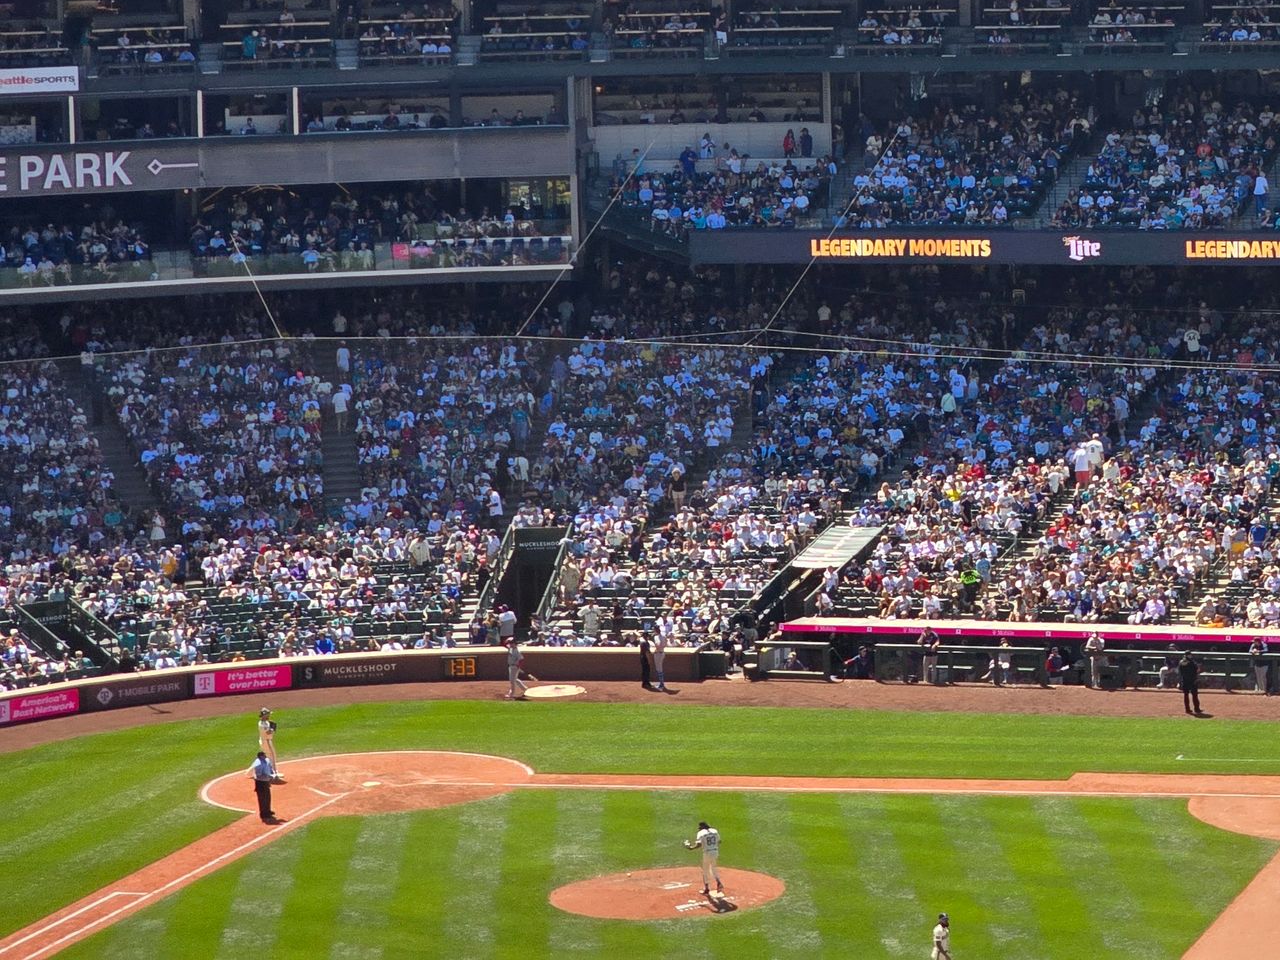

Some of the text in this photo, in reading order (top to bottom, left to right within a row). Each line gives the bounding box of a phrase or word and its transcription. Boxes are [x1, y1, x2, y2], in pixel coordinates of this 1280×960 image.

[20, 152, 132, 190] PARK
[811, 239, 991, 257] LEGENDARY MOMENTS
[1068, 239, 1101, 261] Lite
[227, 670, 278, 681] It's better
[324, 663, 397, 675] MUCKLESHOOT
[118, 683, 180, 698] T-MOBILE PARK
[229, 679, 276, 690] over here
[20, 694, 67, 708] America's
[34, 702, 75, 715] Network
